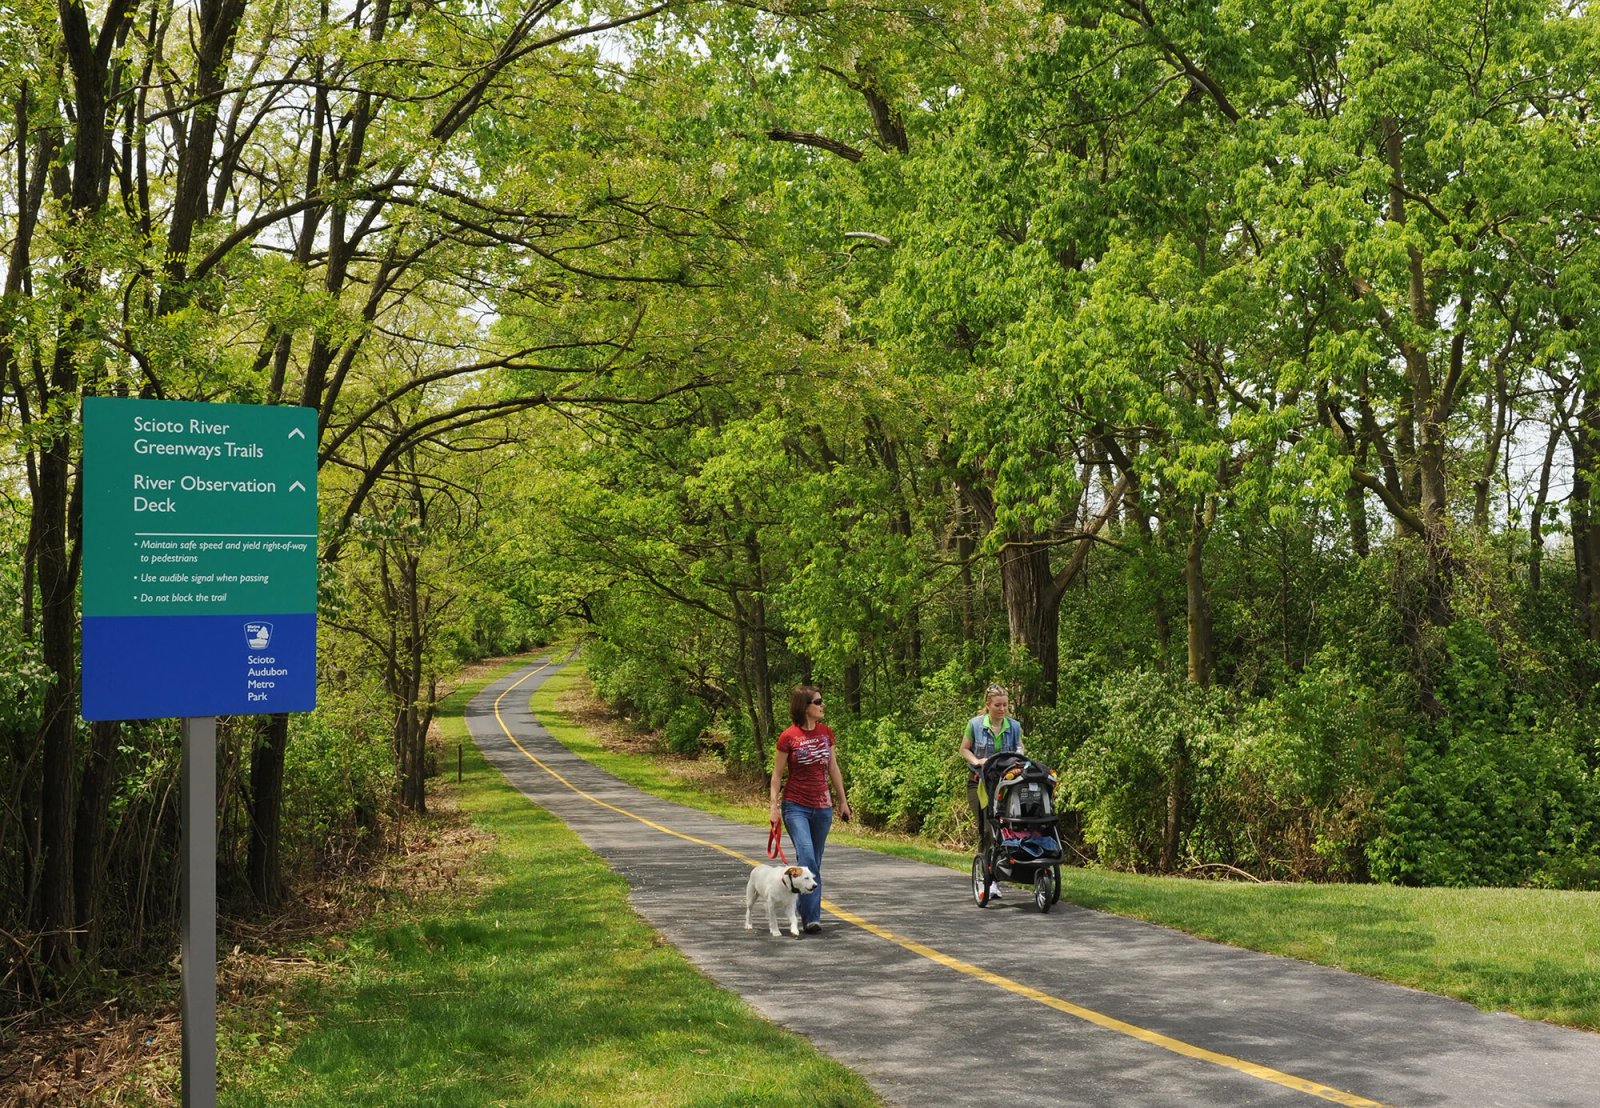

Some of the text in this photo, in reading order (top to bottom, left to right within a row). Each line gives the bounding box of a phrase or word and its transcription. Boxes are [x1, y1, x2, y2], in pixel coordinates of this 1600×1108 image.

[134, 417, 229, 434] Scioto River
[134, 439, 263, 460] Greenways Trails
[134, 475, 275, 492] River Observation
[134, 497, 176, 512] Deck
[141, 540, 307, 553] Maintain safe speed and yield right-of-way
[141, 554, 198, 565] to pedestrians
[141, 573, 269, 585] Use audible signal when passing
[141, 593, 227, 603] Do not block the trail
[248, 655, 275, 665] Scioto
[248, 667, 287, 677] Audubon
[248, 680, 275, 689] Metro
[248, 692, 267, 702] Park
